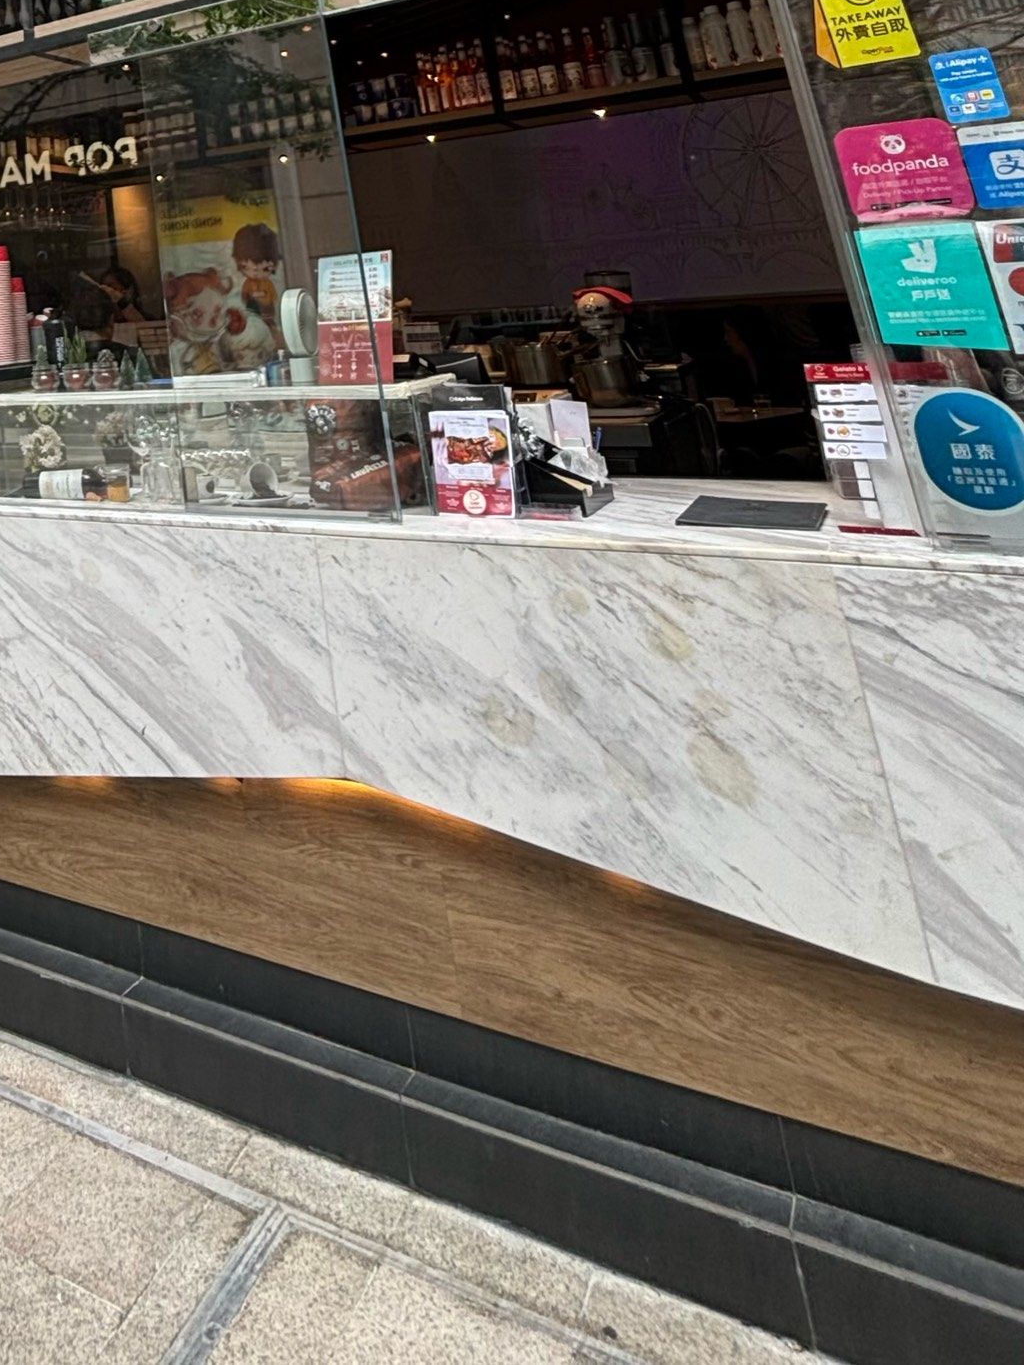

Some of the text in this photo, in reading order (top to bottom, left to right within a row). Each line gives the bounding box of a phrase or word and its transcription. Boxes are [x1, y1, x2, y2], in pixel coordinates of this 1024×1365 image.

[830, 6, 901, 26] TAKEAWAY
[835, 17, 909, 43] 外賣自取
[852, 154, 949, 176] foodpanda
[897, 276, 958, 287] deliveroo
[950, 443, 996, 460] 國泰
